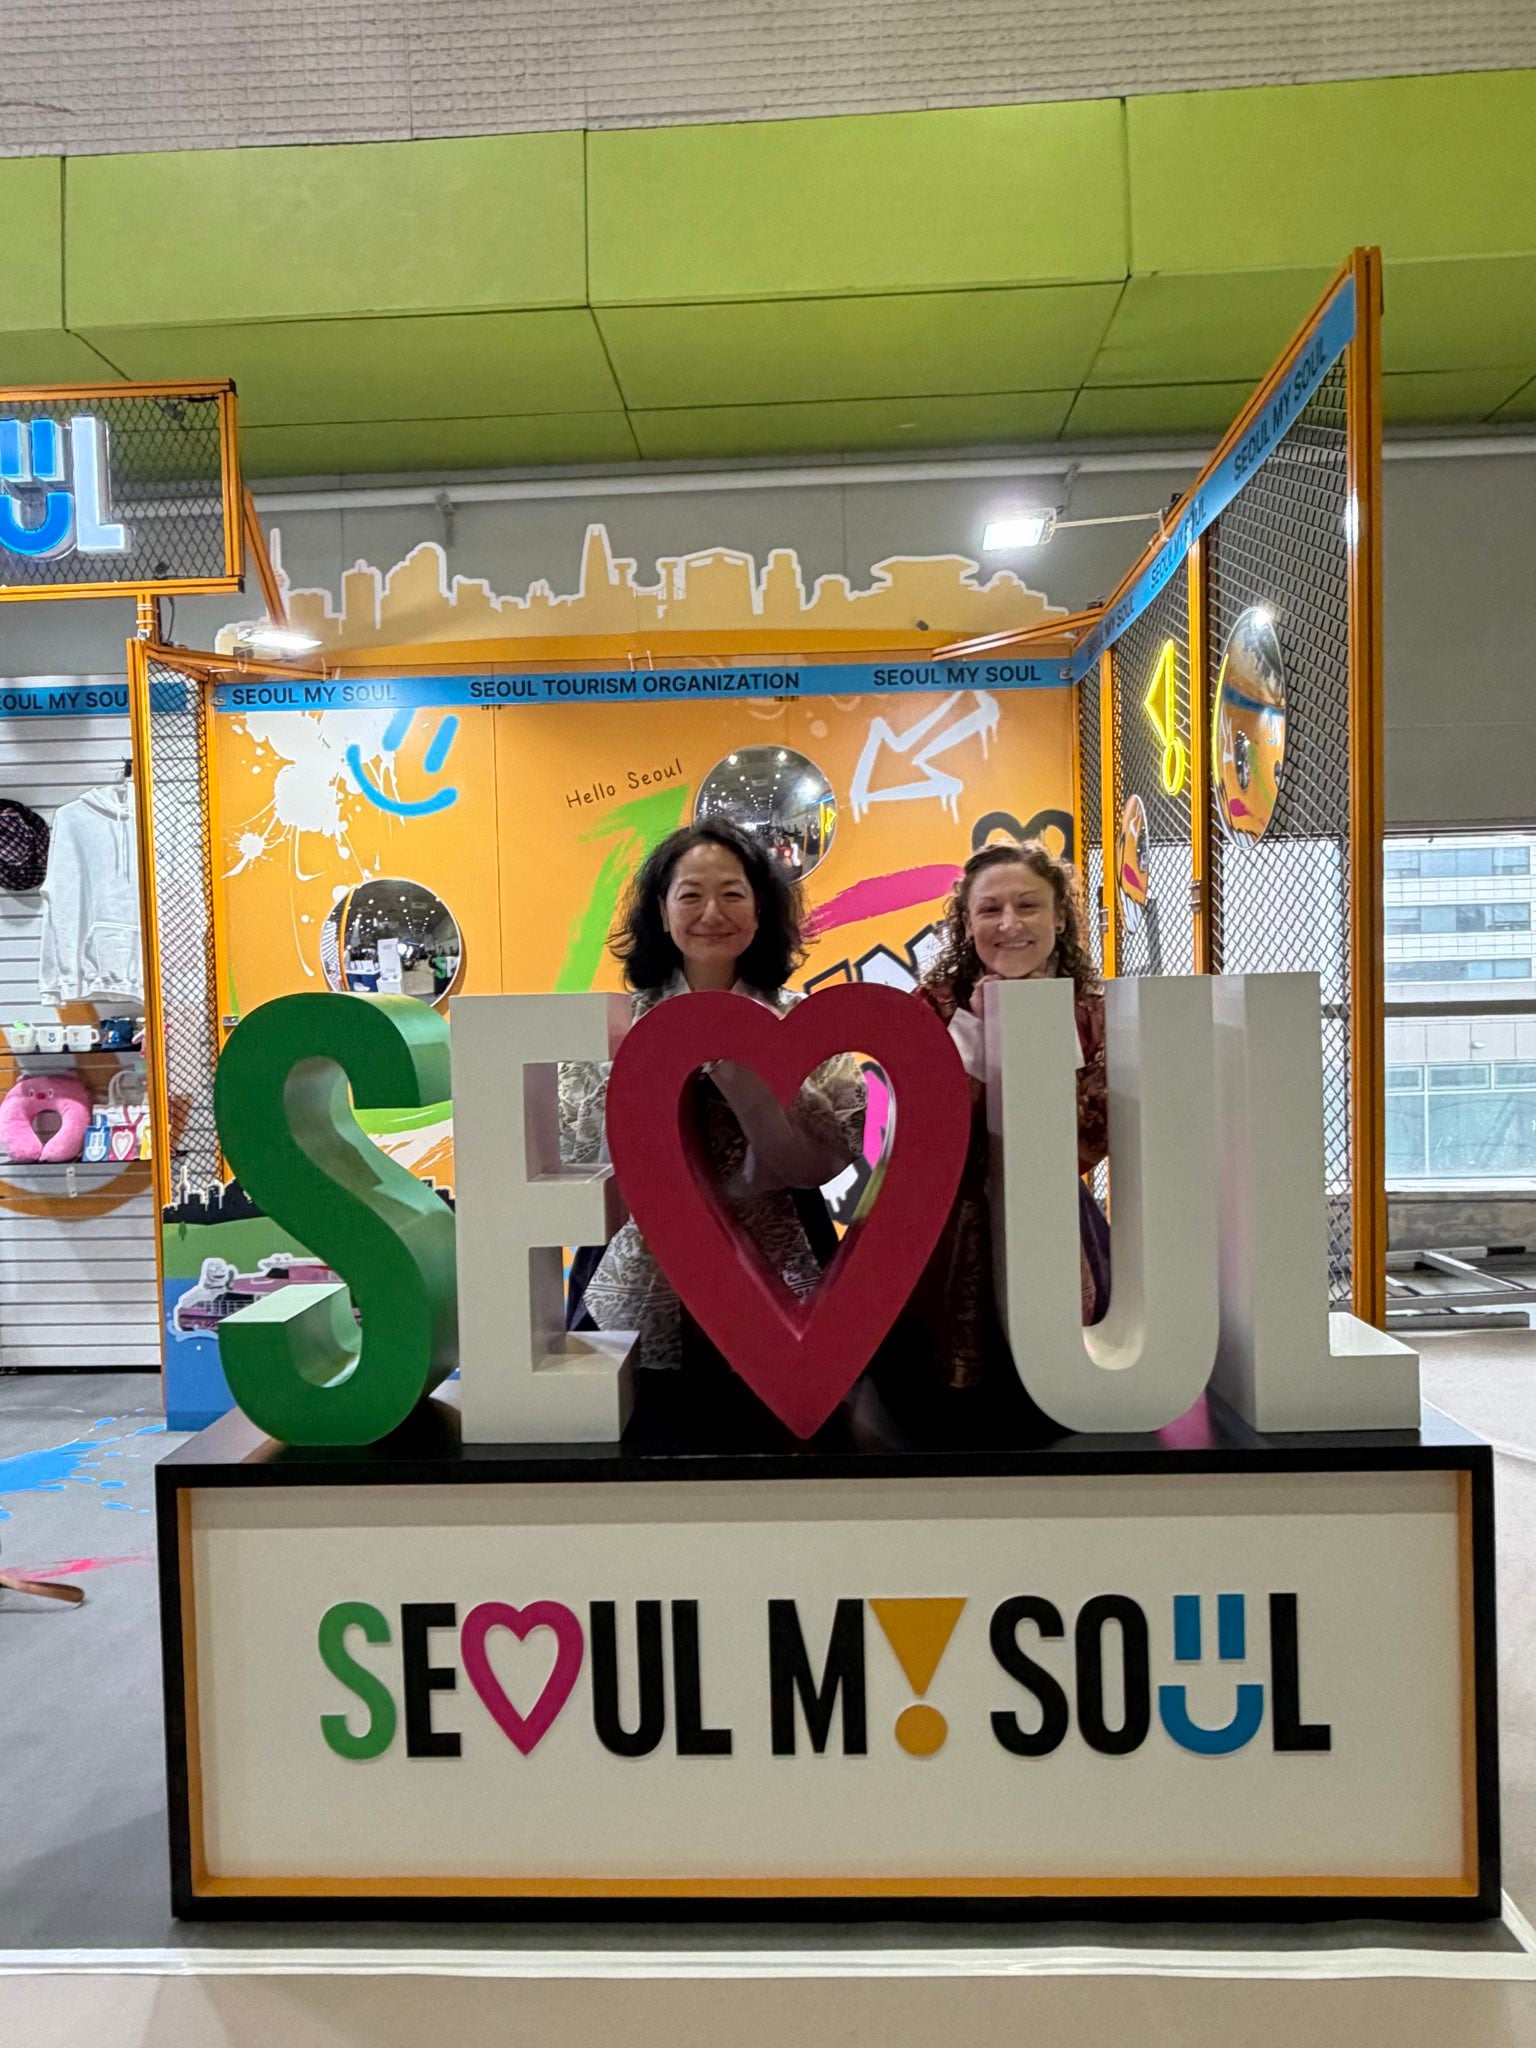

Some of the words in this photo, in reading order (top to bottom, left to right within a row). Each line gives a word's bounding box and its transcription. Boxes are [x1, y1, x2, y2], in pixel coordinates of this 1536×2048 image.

[1233, 418, 1270, 482] SEOUL
[1272, 383, 1292, 433] MY
[1293, 336, 1327, 402] SOUL
[469, 678, 539, 699] SEOUL
[543, 676, 638, 697] TOURISM
[643, 672, 800, 694] ORGANIZATION
[873, 668, 942, 687] SEOUL
[947, 667, 981, 685] MY
[985, 664, 1041, 684] SOUL
[49, 692, 80, 709] MY
[86, 690, 128, 708] SOU
[232, 686, 299, 706] SEOUL
[304, 685, 339, 704] MY
[342, 683, 398, 702] SOUL
[565, 782, 616, 808] Hello
[627, 757, 683, 789] Seoul
[989, 1592, 1332, 1758] SOUL
